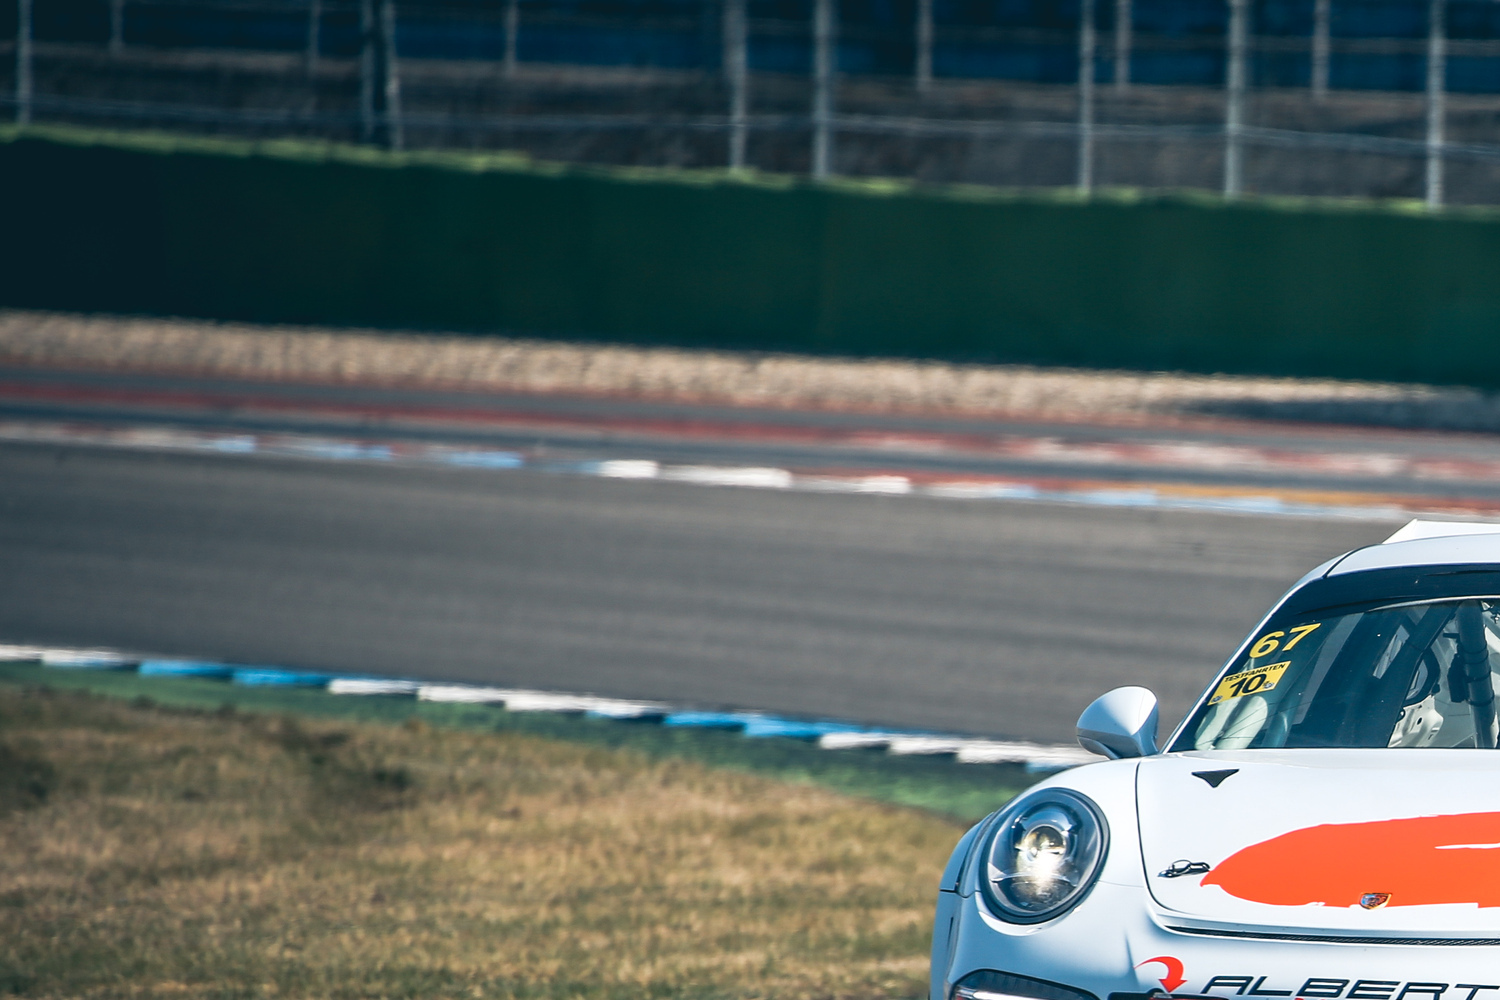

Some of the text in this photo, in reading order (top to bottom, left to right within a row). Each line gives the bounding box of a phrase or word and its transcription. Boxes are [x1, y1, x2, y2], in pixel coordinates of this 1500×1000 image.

[1249, 622, 1322, 659] 67
[1224, 663, 1286, 683] TESTFAHRTEN
[1229, 673, 1268, 698] 10
